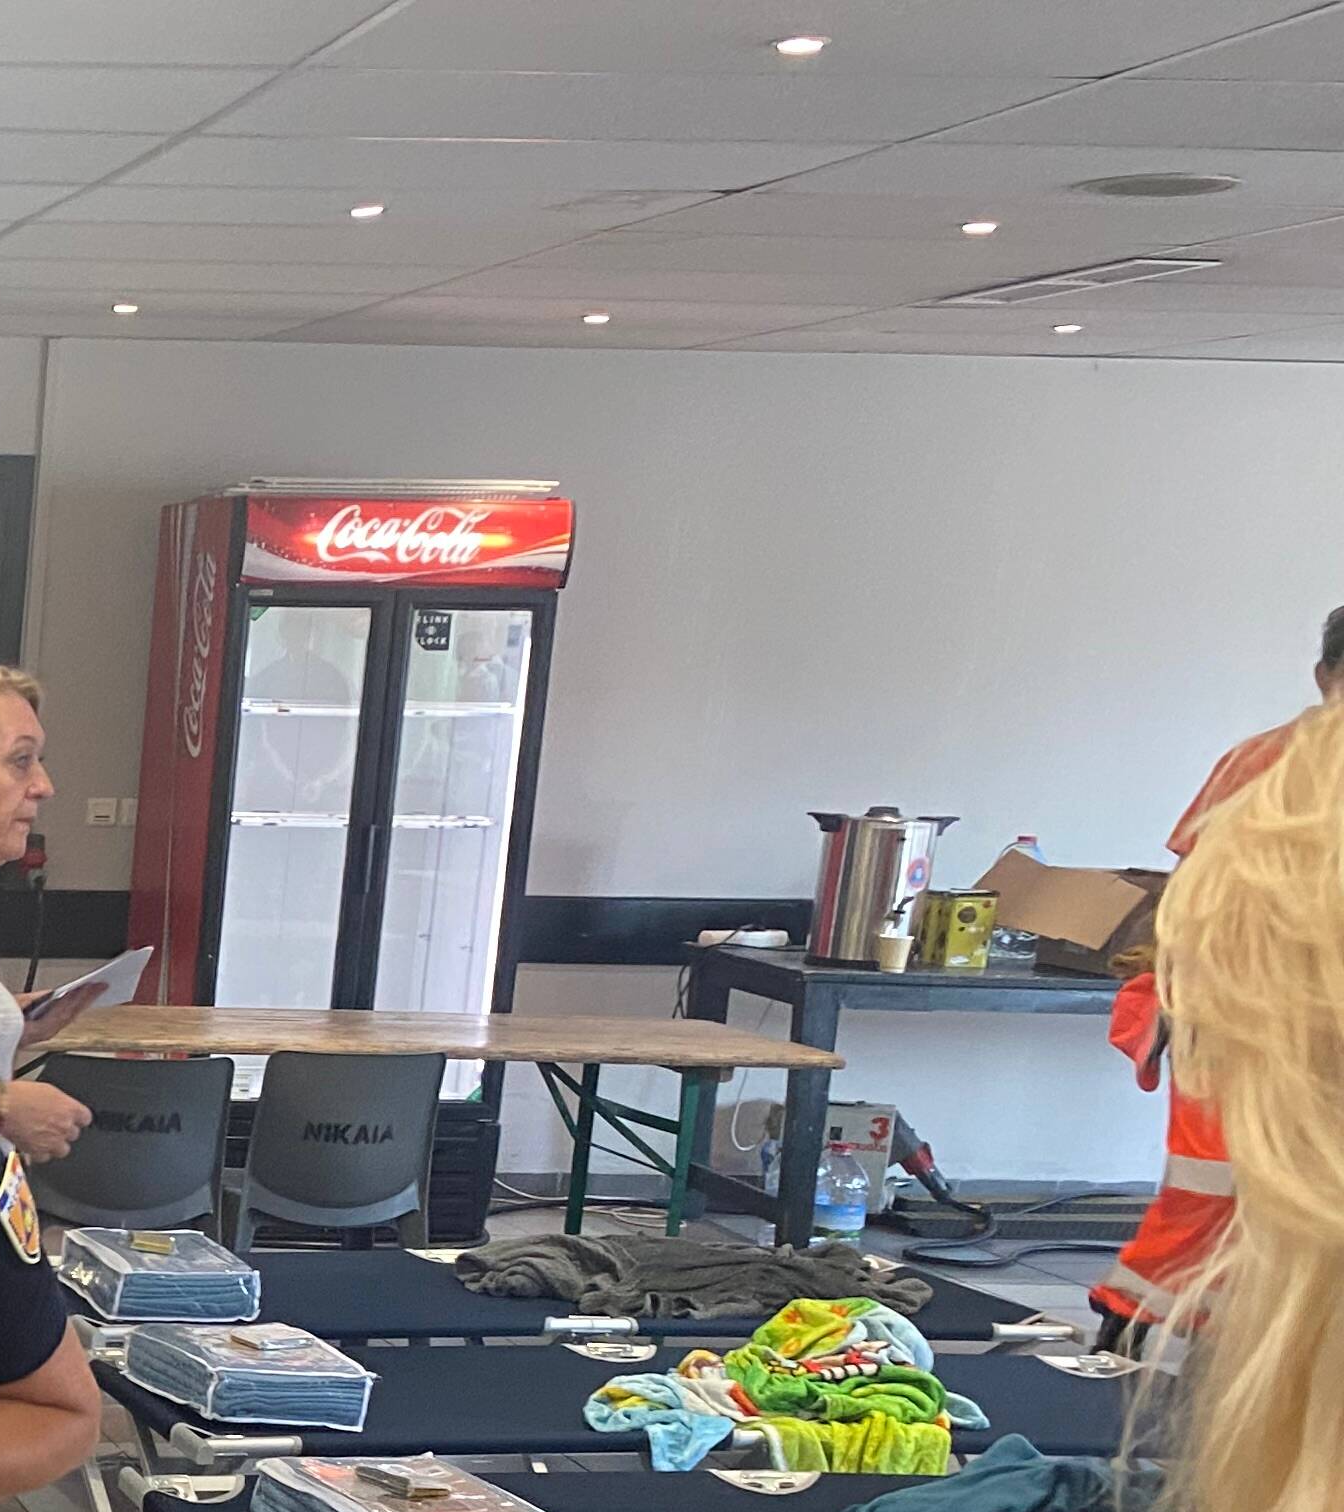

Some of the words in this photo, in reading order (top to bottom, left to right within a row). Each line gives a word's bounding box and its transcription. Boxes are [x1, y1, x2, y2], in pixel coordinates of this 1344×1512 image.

[314, 503, 493, 567] Coca-Cola
[185, 551, 217, 757] Coca-Cola
[303, 1120, 395, 1145] NIKAIA
[869, 1116, 890, 1140] 3
